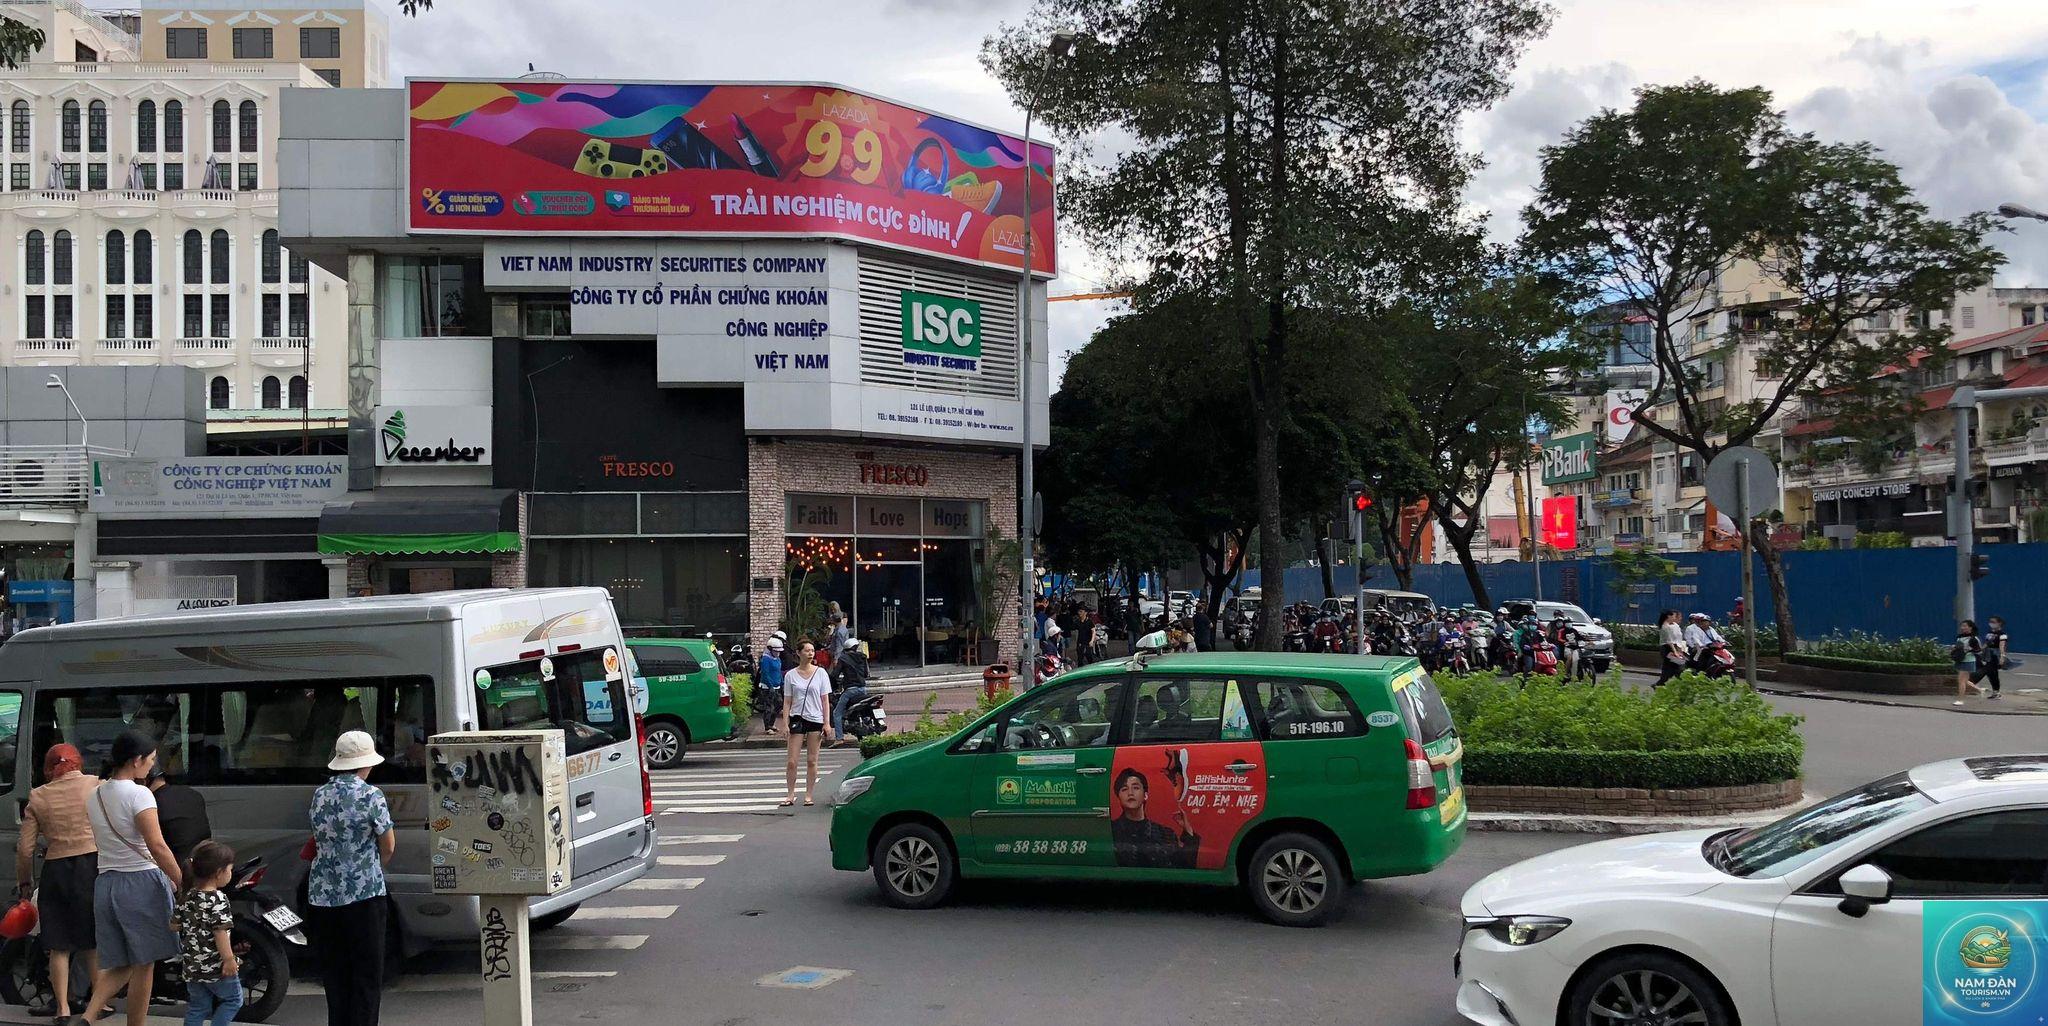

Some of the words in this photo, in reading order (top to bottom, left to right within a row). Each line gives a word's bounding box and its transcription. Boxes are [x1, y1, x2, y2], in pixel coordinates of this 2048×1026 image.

[822, 103, 872, 127] LAZADA
[483, 195, 499, 203] 50%
[710, 188, 768, 215] TRẢI
[773, 193, 863, 224] NGHIỆM
[866, 206, 904, 233] CỰC
[500, 256, 534, 272] VIET
[538, 256, 573, 272] NAM
[579, 256, 654, 272] INDUSTRY
[660, 257, 747, 273] SECURITIES
[752, 257, 827, 273] COMPANY
[571, 285, 613, 305] CÔNG
[616, 289, 638, 305] TY
[642, 282, 664, 305] CỔ
[669, 283, 712, 305] PHẦN
[717, 284, 770, 305] CHỨNG
[776, 286, 828, 305] KHOÁN
[725, 318, 768, 338] CÔNG
[773, 318, 829, 341] NGHIỆP
[911, 301, 974, 348] ISC
[754, 353, 788, 373] VIỆT
[794, 354, 830, 370] NAM
[903, 351, 941, 368] INDUSTRY
[941, 356, 978, 372] SECURITIE
[380, 428, 486, 462] December
[162, 463, 202, 477] CÔNG
[203, 465, 222, 477] TY
[224, 465, 242, 477] CP
[243, 462, 292, 477] CHỨNG
[295, 461, 343, 477] KHOÁN
[603, 461, 674, 477] FRESCO
[859, 462, 929, 487] FRESCO
[174, 477, 214, 491] CÔNG
[215, 477, 266, 491] NGHIỆP
[269, 477, 299, 491] VIỆT
[301, 478, 332, 490] NAM
[1812, 489, 1841, 503] GINKGO
[1842, 485, 1881, 499] CONCEPT
[1882, 483, 1912, 496] STORE
[796, 505, 839, 526] Faith
[869, 506, 905, 527] Love
[933, 507, 969, 530] Hope
[1289, 720, 1345, 735] 51F-196.10
[1371, 714, 1395, 724] 8537
[1025, 798, 1077, 806] CORPORATION
[1187, 794, 1206, 807] CAO
[1212, 791, 1231, 807] ÊM
[1235, 794, 1259, 809] NHẸ
[1013, 840, 1030, 854] 38
[1031, 840, 1049, 854] 38
[1050, 840, 1068, 854] 38
[1069, 840, 1088, 854] 38
